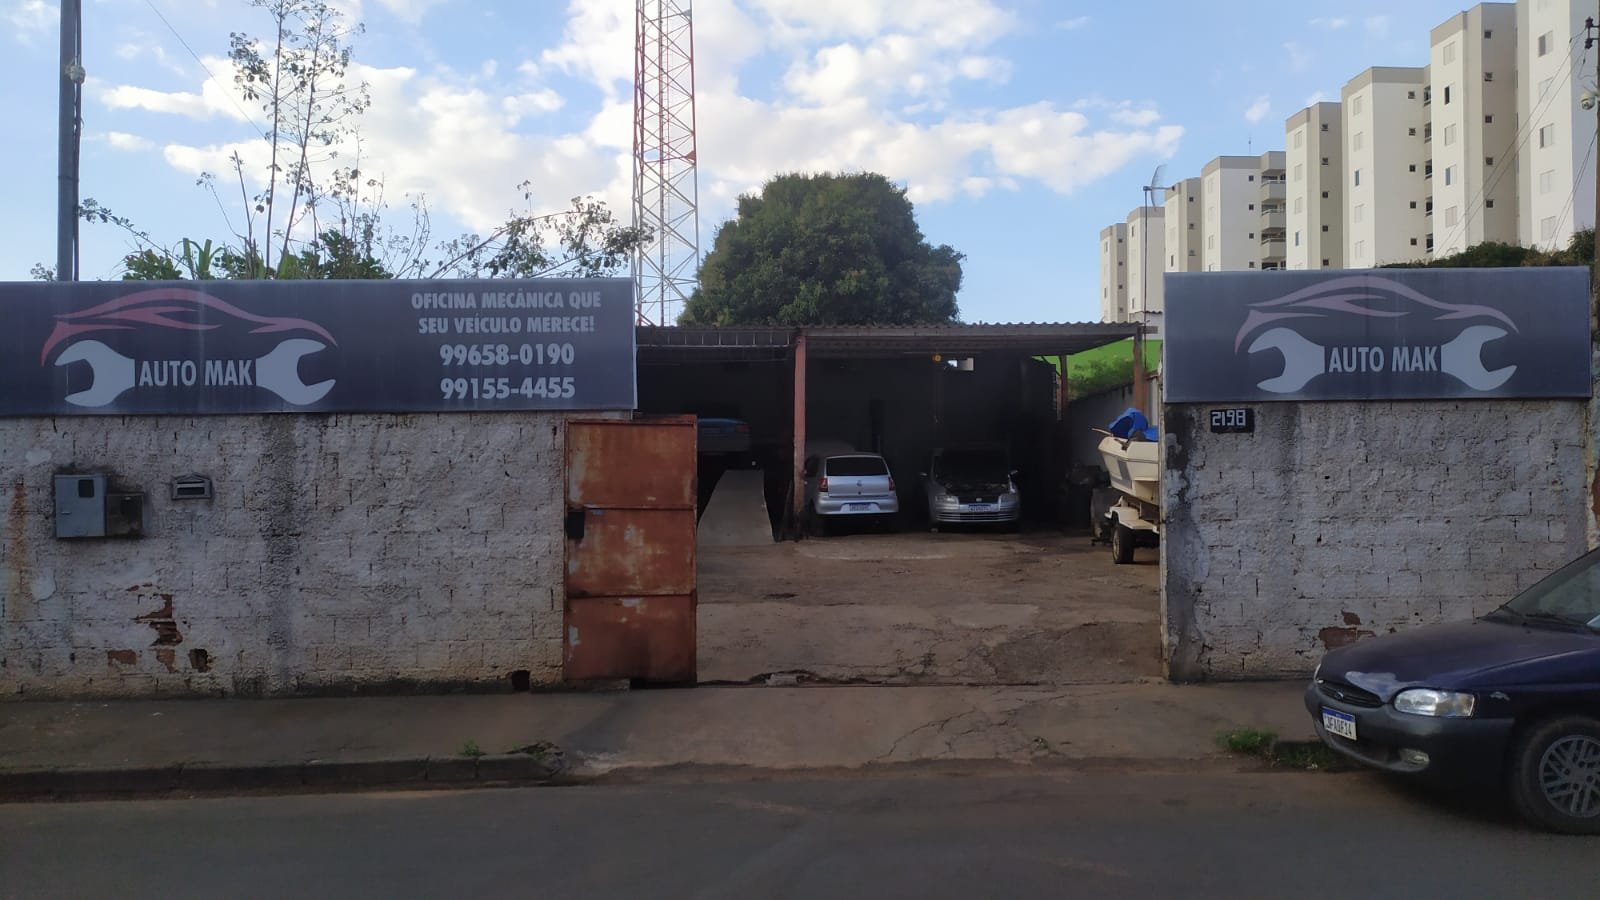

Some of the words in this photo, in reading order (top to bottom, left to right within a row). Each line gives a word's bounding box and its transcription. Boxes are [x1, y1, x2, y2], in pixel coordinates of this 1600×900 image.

[411, 292, 477, 309] OFICINA
[481, 288, 564, 308] MECÂNICA
[569, 291, 602, 309] QUE
[418, 317, 449, 334] SEU
[454, 313, 522, 333] VEÍCULO
[526, 316, 595, 333] MERECE!
[440, 343, 575, 365] 99658-0190
[1328, 346, 1385, 373] AUTO
[1391, 346, 1438, 372] MAK
[139, 360, 197, 386] AUTO
[205, 359, 254, 386] MAK
[440, 377, 576, 399] 99155-4455
[1211, 409, 1246, 426] 2198
